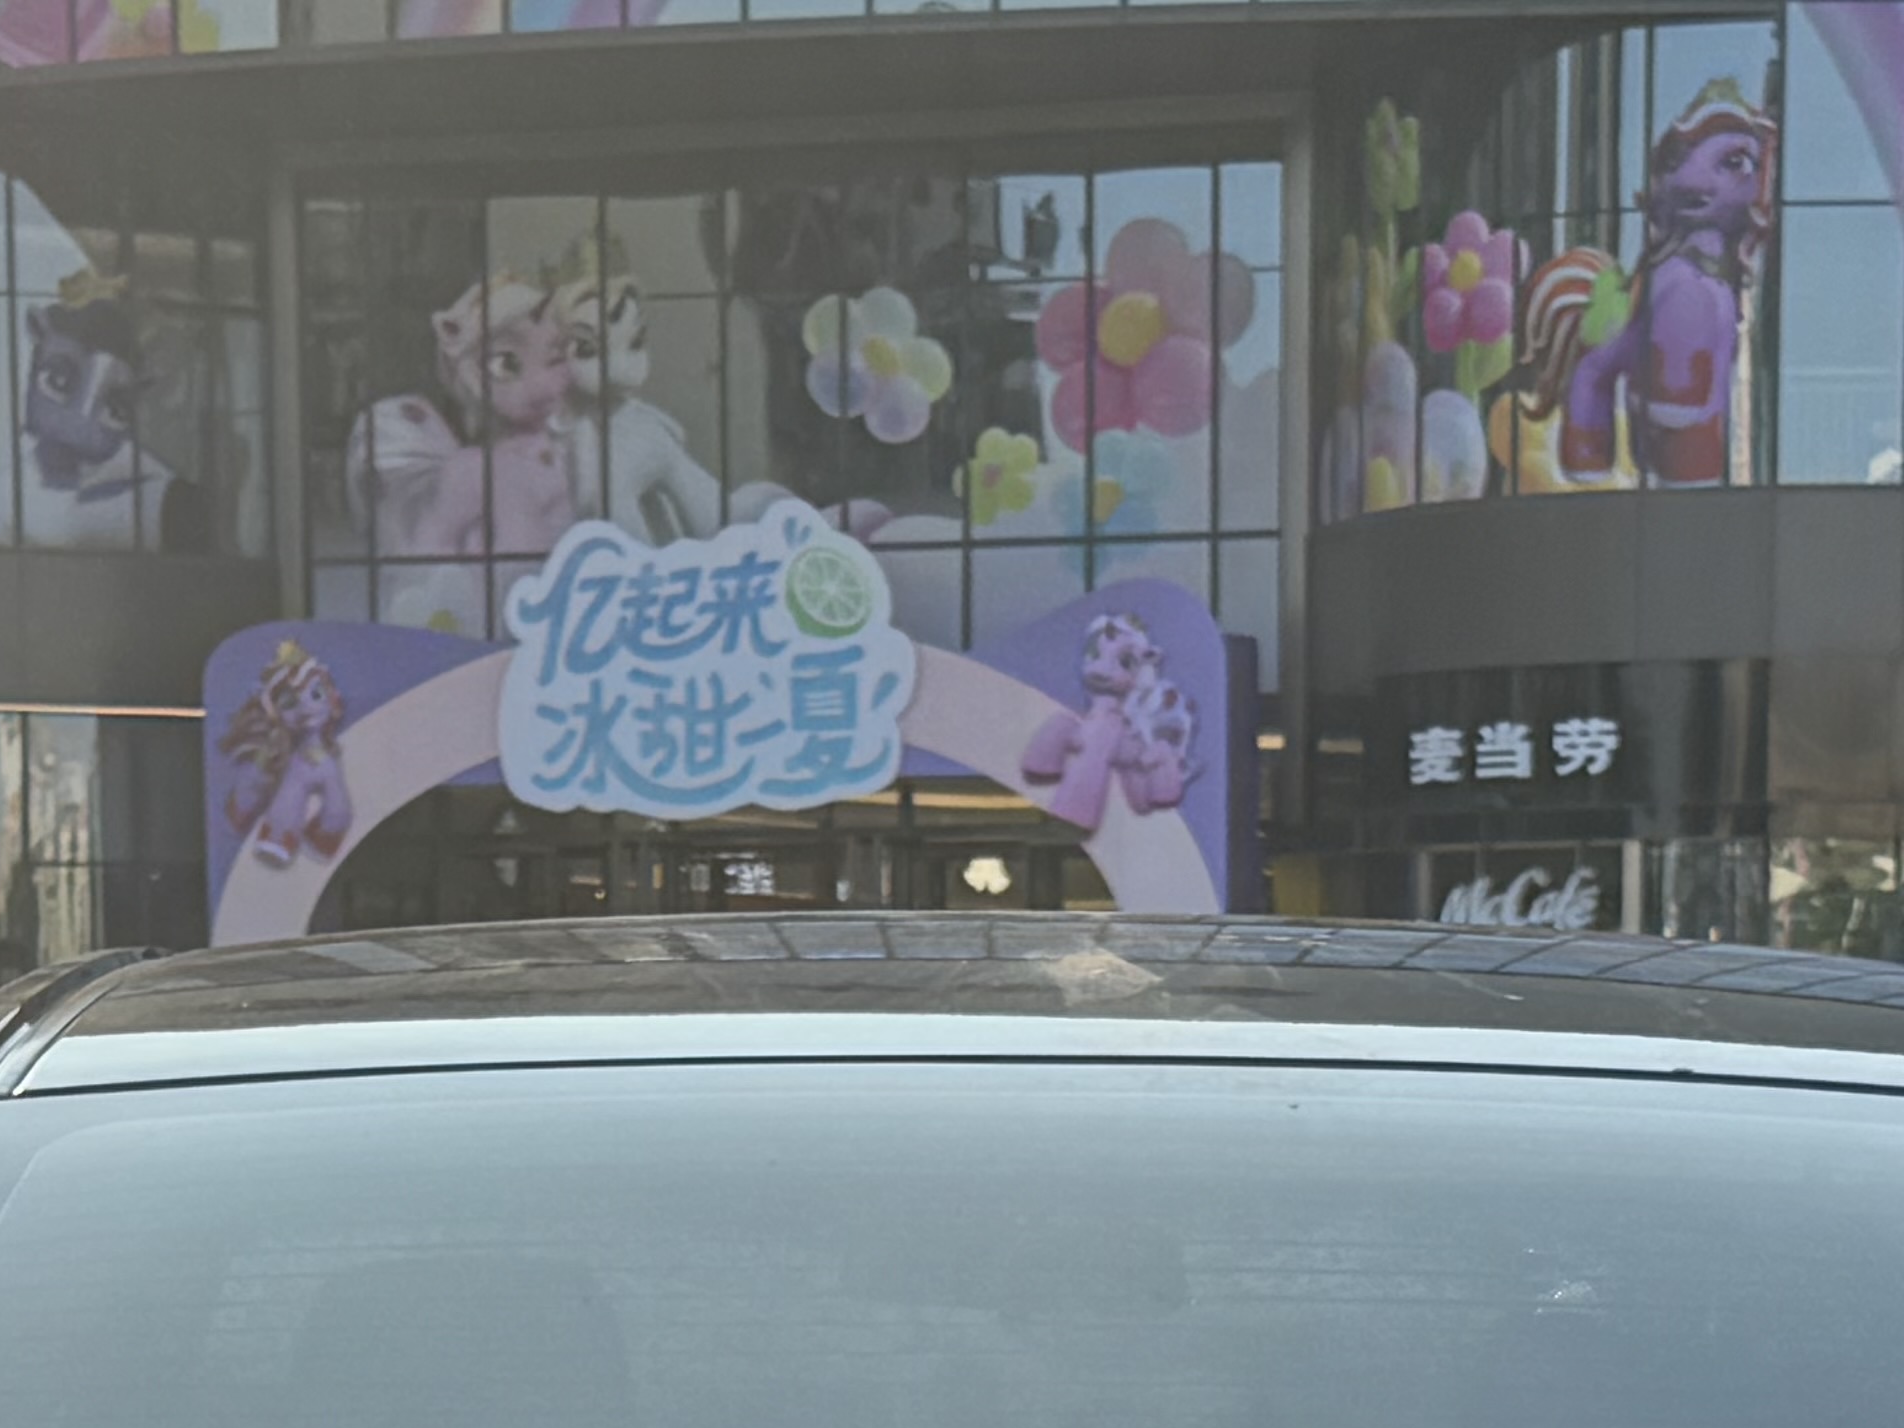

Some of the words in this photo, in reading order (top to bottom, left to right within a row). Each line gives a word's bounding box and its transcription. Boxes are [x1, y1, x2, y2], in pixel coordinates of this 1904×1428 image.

[518, 536, 790, 687] 亿起来
[532, 644, 895, 805] 冰甜一夏
[1408, 717, 1620, 785] 麦当劳
